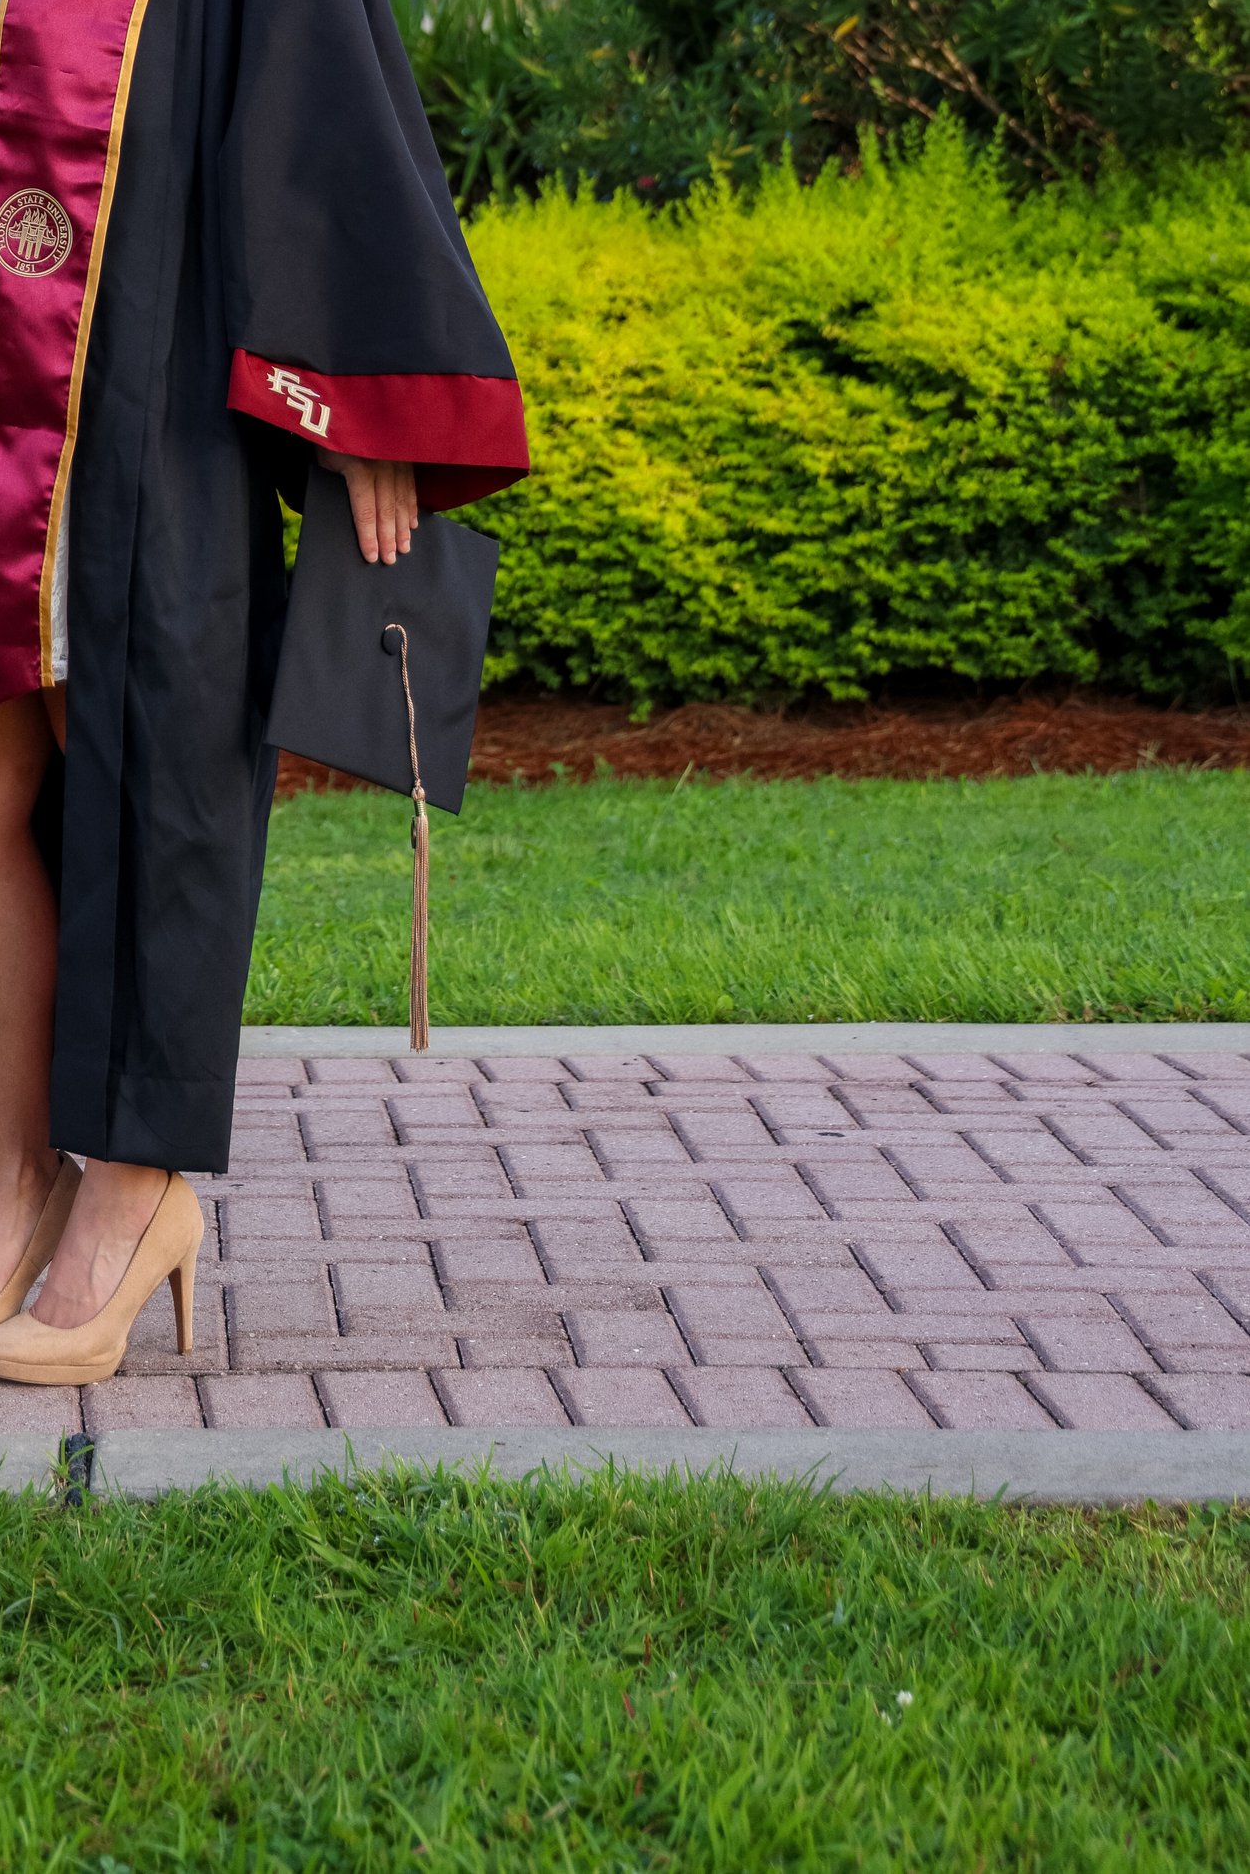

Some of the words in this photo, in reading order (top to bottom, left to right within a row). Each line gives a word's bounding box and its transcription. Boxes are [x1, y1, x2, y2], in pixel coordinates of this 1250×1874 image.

[17, 195, 44, 207] STATE
[46, 201, 68, 263] UNIVERSITY
[14, 262, 35, 272] 1851
[266, 365, 332, 438] FSU
